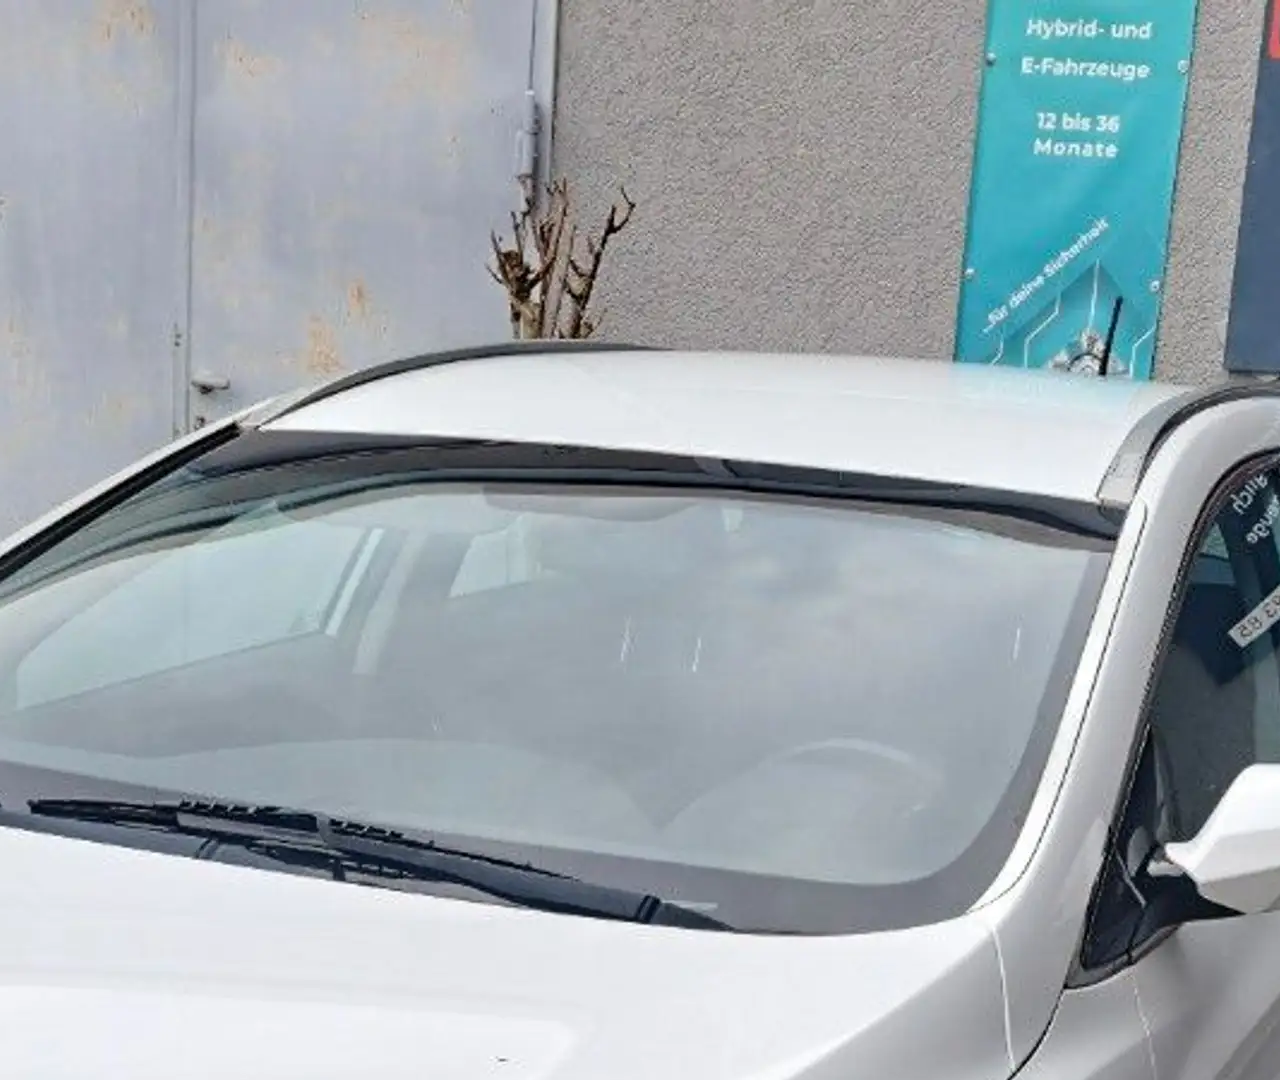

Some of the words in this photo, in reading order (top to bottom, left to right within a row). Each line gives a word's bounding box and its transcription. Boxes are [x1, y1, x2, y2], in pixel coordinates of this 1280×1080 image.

[1025, 18, 1105, 40] Hybrid-
[1111, 21, 1153, 39] und
[1021, 56, 1151, 81] E-Fahrzeuge
[1037, 112, 1057, 130] 12
[1062, 112, 1091, 131] bis
[1096, 115, 1121, 133] 36
[1033, 138, 1119, 158] Monate
